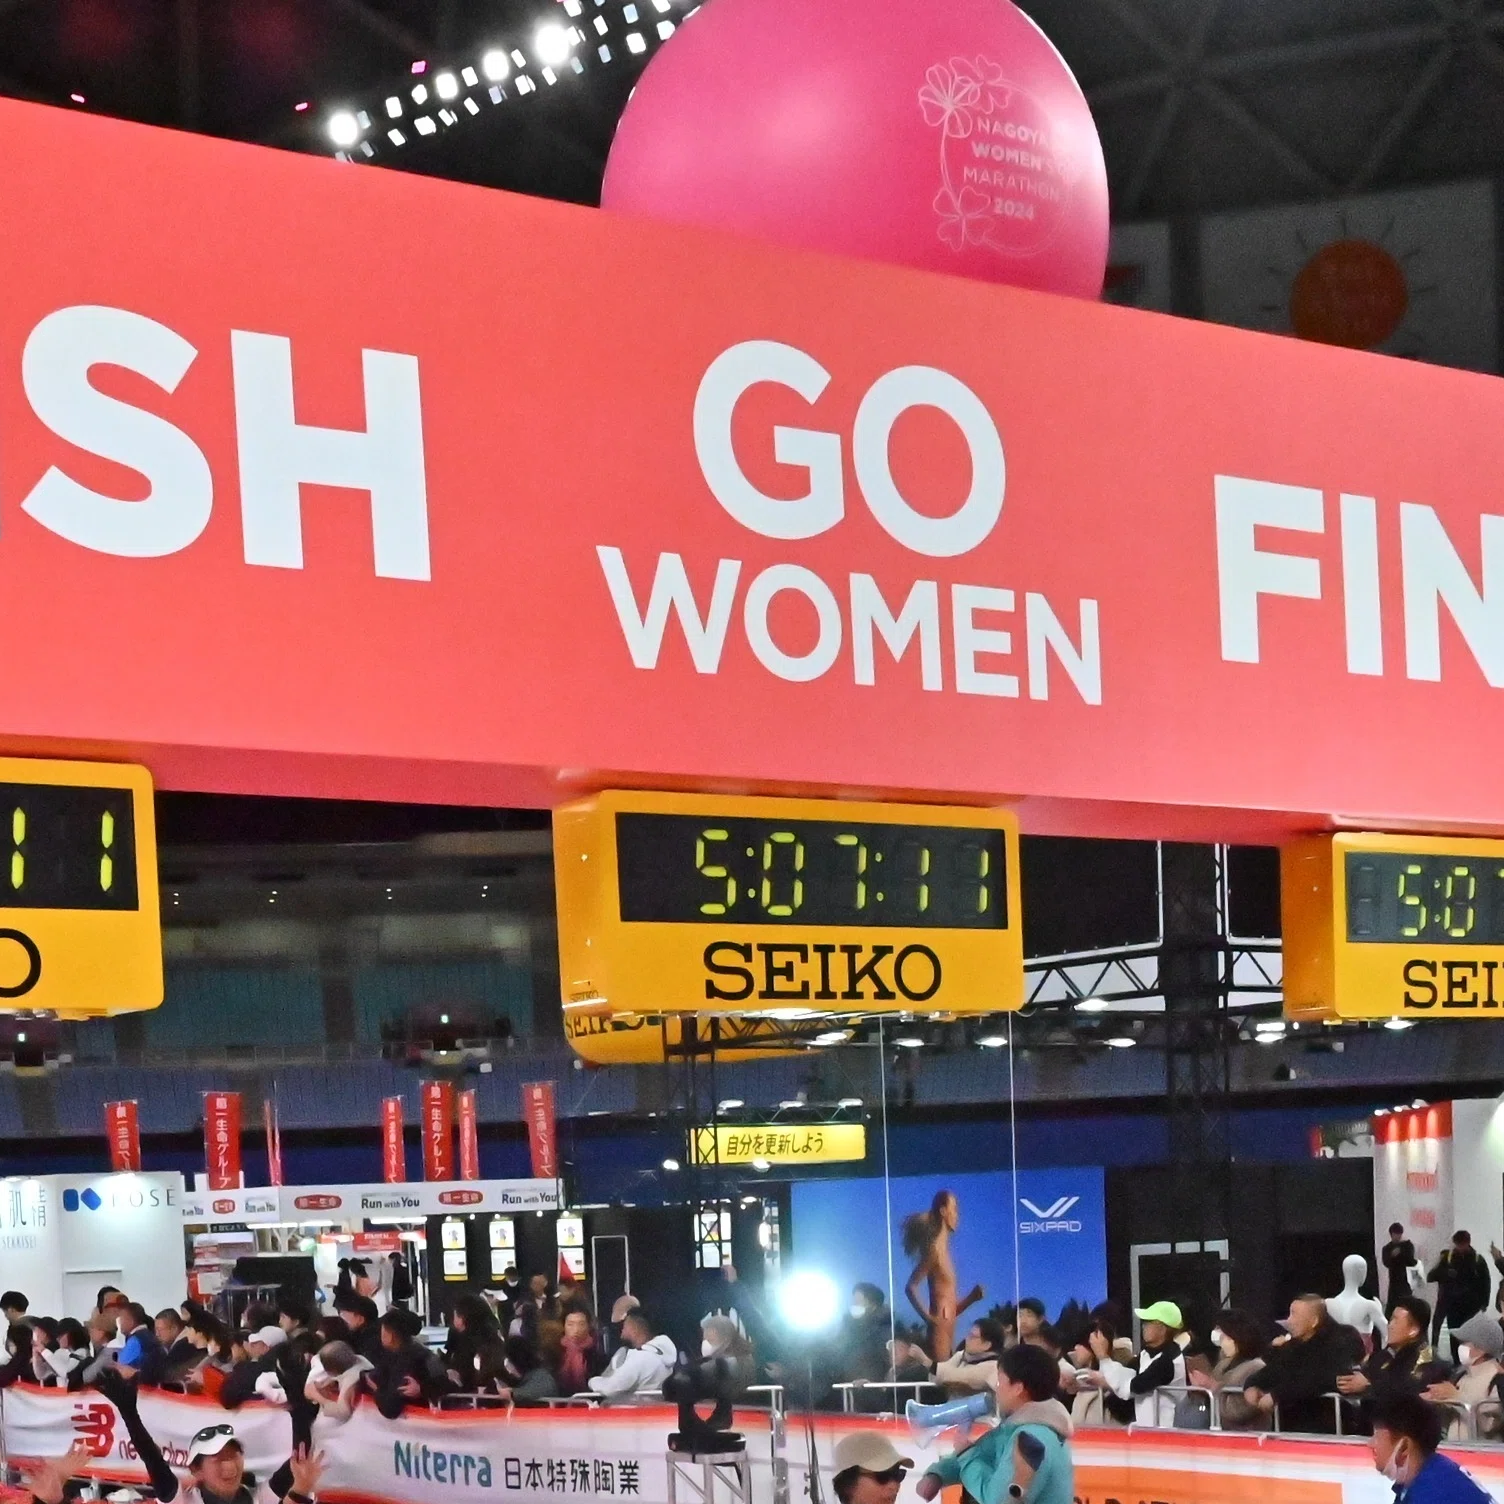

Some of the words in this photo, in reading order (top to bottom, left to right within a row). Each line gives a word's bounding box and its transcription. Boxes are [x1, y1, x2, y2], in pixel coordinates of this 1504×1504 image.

[977, 116, 1048, 147] NAGOYA
[963, 166, 1060, 202] MARATHON
[993, 197, 1035, 221] 2024
[693, 339, 1007, 558] GO
[595, 545, 1102, 706] WOMEN
[696, 828, 989, 916] 5:07:11
[702, 940, 942, 1002] SEIKO
[361, 1198, 383, 1209] Run
[401, 1196, 420, 1208] You
[502, 1193, 522, 1205] Run
[539, 1191, 557, 1203] You
[1019, 1220, 1082, 1234] SIXPAD
[395, 1439, 492, 1488] Niterra
[504, 1457, 640, 1495] 日本特殊陶業
